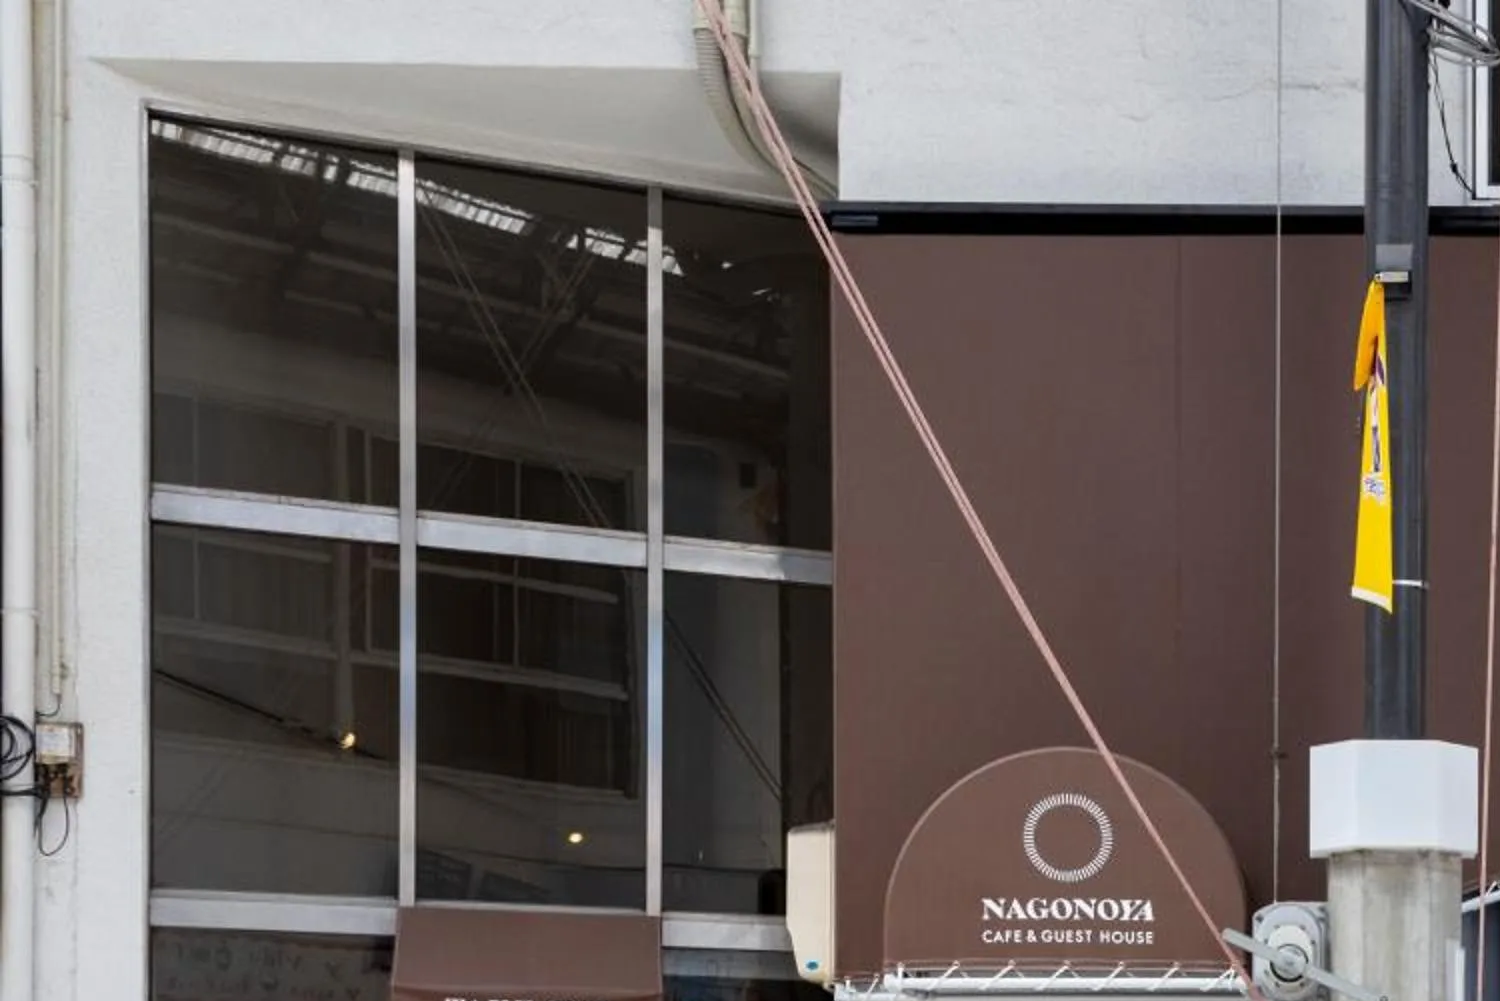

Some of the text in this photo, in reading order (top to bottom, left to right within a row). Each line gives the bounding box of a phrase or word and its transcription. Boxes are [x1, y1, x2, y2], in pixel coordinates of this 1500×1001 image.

[981, 897, 1155, 922] NAGONOYA
[981, 929, 1154, 945] CAFE & GUEST HOUSE
